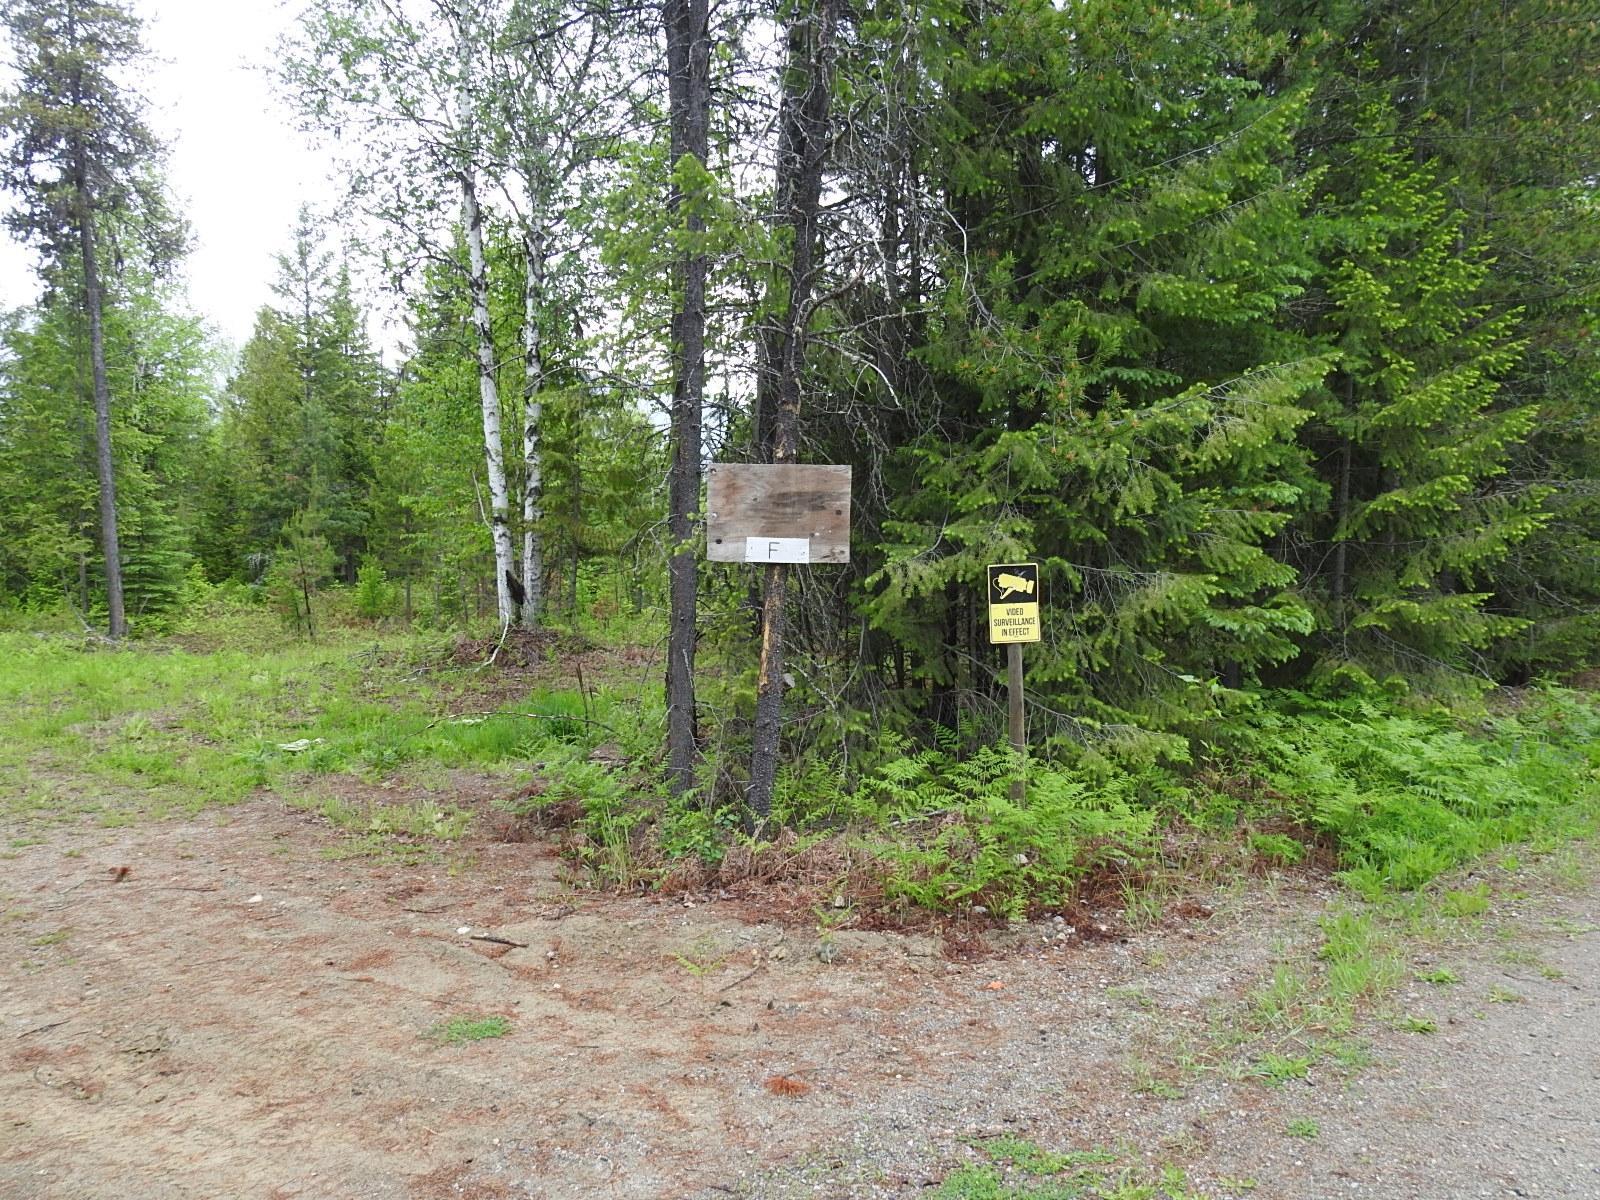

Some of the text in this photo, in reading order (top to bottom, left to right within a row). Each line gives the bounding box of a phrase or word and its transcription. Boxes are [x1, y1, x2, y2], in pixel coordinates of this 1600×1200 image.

[768, 541, 780, 560] F
[1006, 608, 1023, 616] VIDEO
[993, 617, 1036, 627] SURVEILLANCE
[1001, 627, 1030, 637] IN EFFECT
